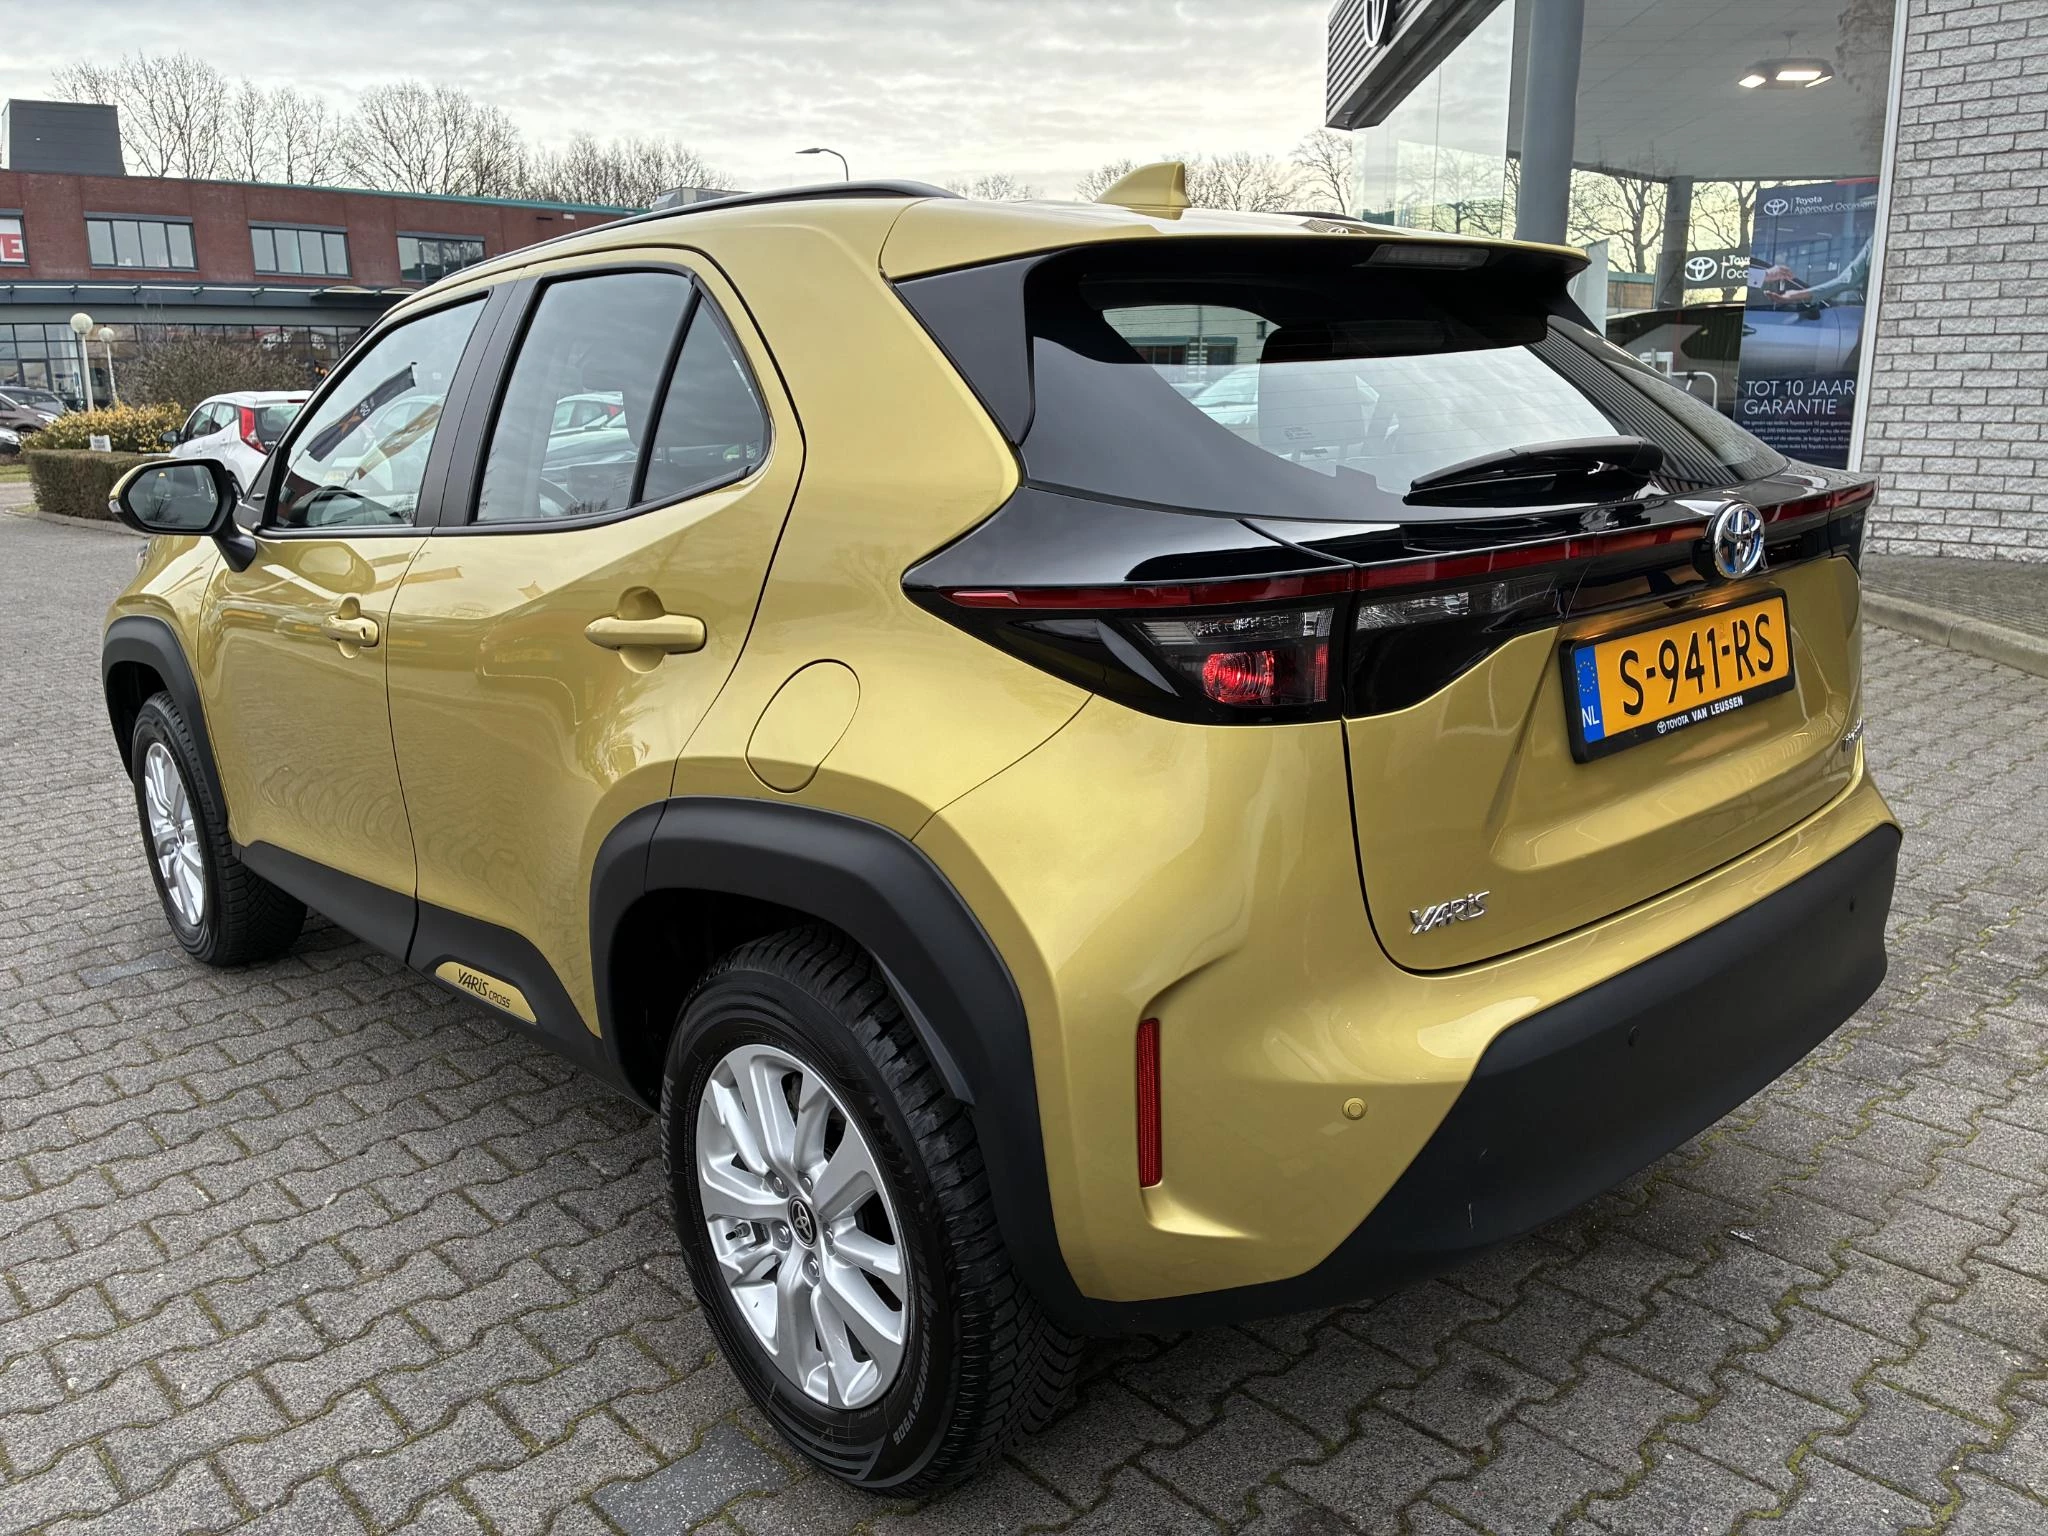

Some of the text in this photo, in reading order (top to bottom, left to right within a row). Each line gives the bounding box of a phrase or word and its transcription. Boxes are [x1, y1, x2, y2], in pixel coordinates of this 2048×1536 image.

[1794, 203, 1834, 215] Approved
[1795, 196, 1823, 205] Toyota
[1745, 379, 1855, 396] TOT 10 JAAR
[1744, 398, 1838, 415] GARANTIE
[1619, 613, 1774, 716] S-941-RS
[1581, 704, 1599, 728] NL
[1666, 695, 1744, 730] TOYOTA VAN LEUSSEN
[1410, 890, 1490, 934] YARIS
[457, 968, 511, 1008] YARIS CROSS
[660, 1074, 678, 1224] OKOHAMA
[892, 1409, 917, 1445] V906
